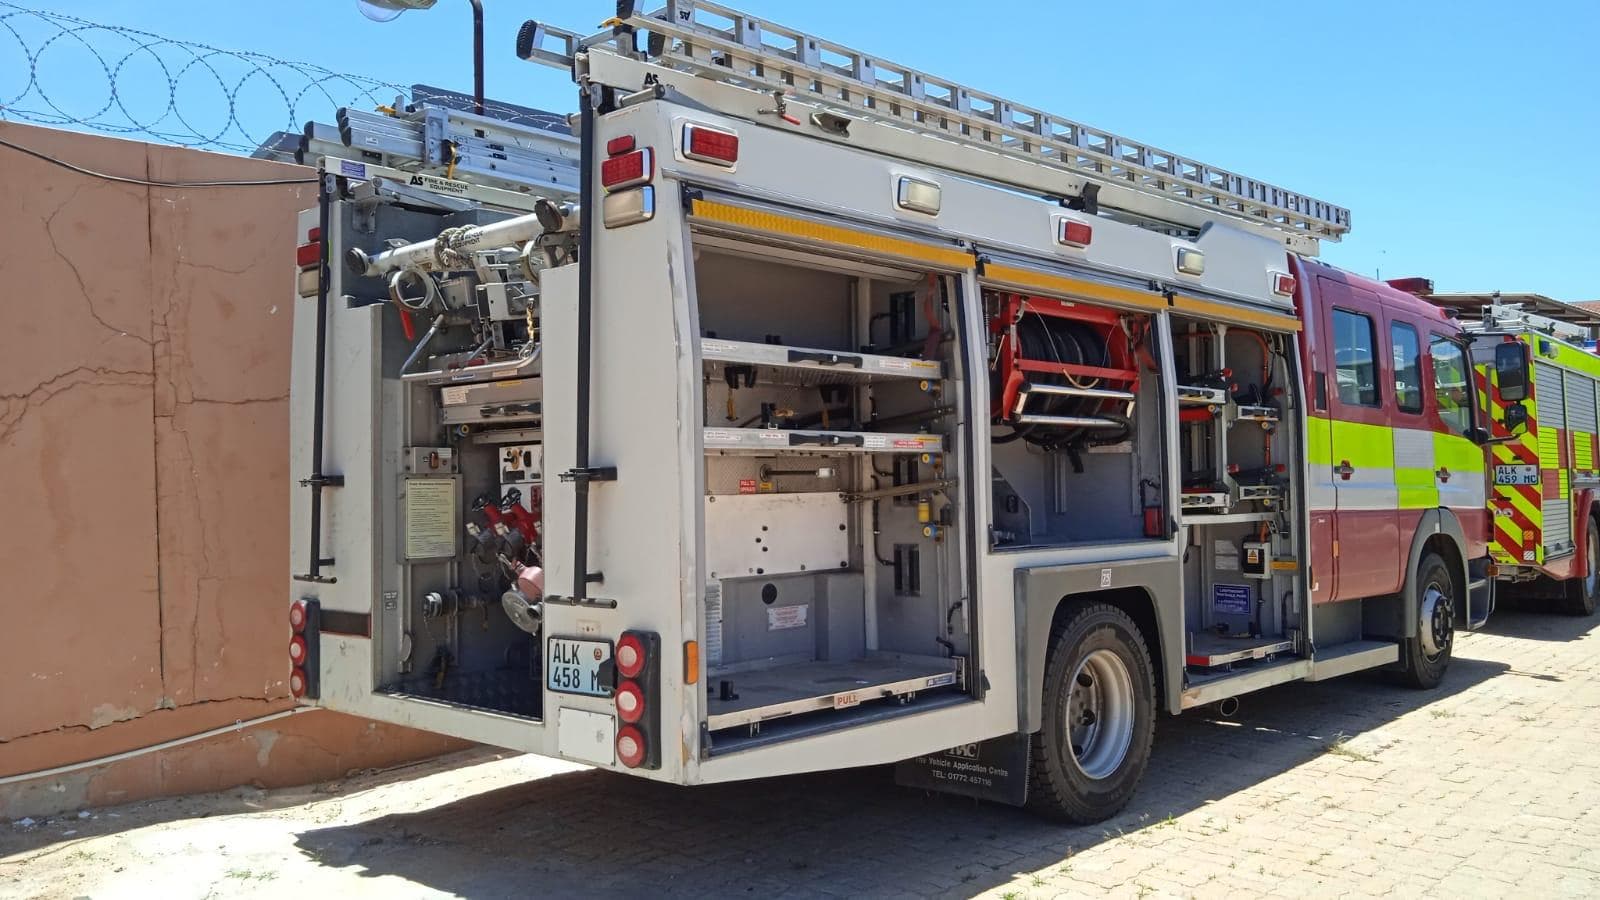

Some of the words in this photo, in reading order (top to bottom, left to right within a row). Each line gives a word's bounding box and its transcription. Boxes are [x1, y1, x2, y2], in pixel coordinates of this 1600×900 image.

[644, 72, 659, 84] AS
[410, 176, 424, 185] AS
[424, 177, 438, 185] FIRE
[445, 181, 469, 190] RESCUE
[430, 184, 465, 194] EQUIPMENT
[1498, 466, 1517, 475] ALK
[1498, 475, 1518, 483] 459
[1523, 475, 1537, 483] MC
[553, 643, 580, 665] ALK
[553, 667, 580, 688] 458
[591, 670, 608, 691] M
[837, 695, 858, 706] PULL
[928, 757, 951, 767] Vehicle
[953, 761, 987, 773] Application
[988, 766, 1009, 777] Centre
[947, 773, 968, 782] 01772
